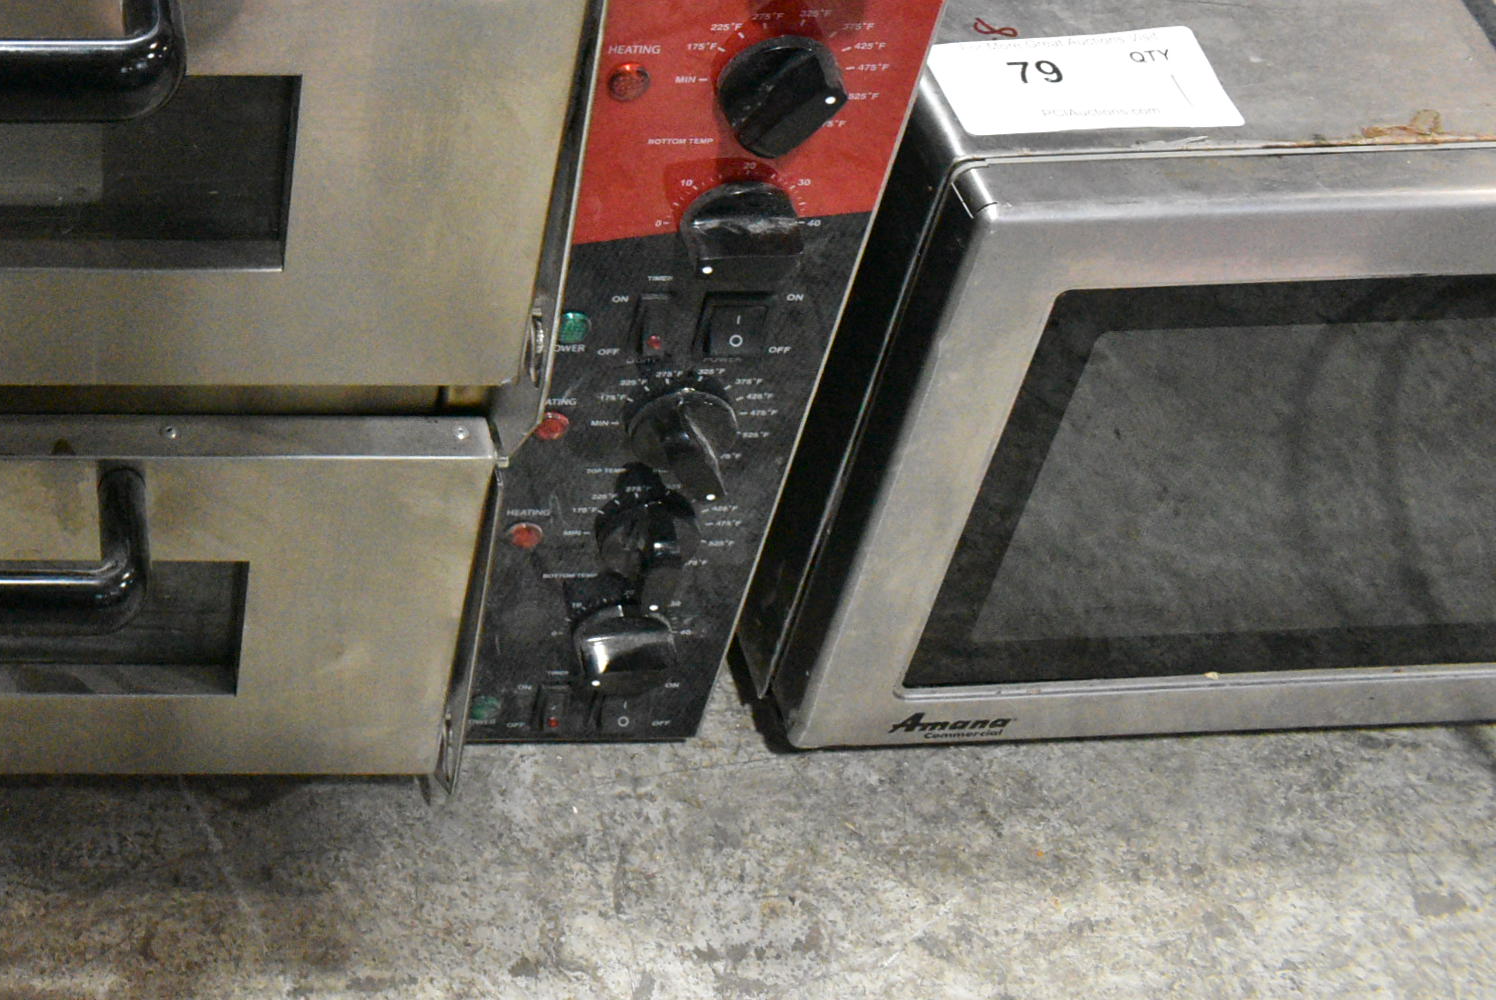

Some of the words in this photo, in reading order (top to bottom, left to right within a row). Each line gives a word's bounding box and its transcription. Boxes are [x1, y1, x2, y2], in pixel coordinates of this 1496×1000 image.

[608, 45, 661, 55] HEATING
[1129, 49, 1169, 64] QTY
[1006, 59, 1065, 85] 79
[675, 76, 697, 84] MIN
[647, 137, 686, 145] BOTTOM
[687, 137, 715, 145] TEMP
[679, 178, 694, 187] 10
[797, 178, 812, 187] 30
[807, 219, 822, 227] 40
[611, 295, 630, 303] ON
[786, 293, 804, 301] ON
[553, 344, 586, 353] OWER
[597, 347, 620, 356] OFF
[768, 346, 792, 354] OFF
[506, 508, 551, 517] HEATING
[888, 712, 1012, 733] Amana
[924, 728, 1004, 739] Commercial
